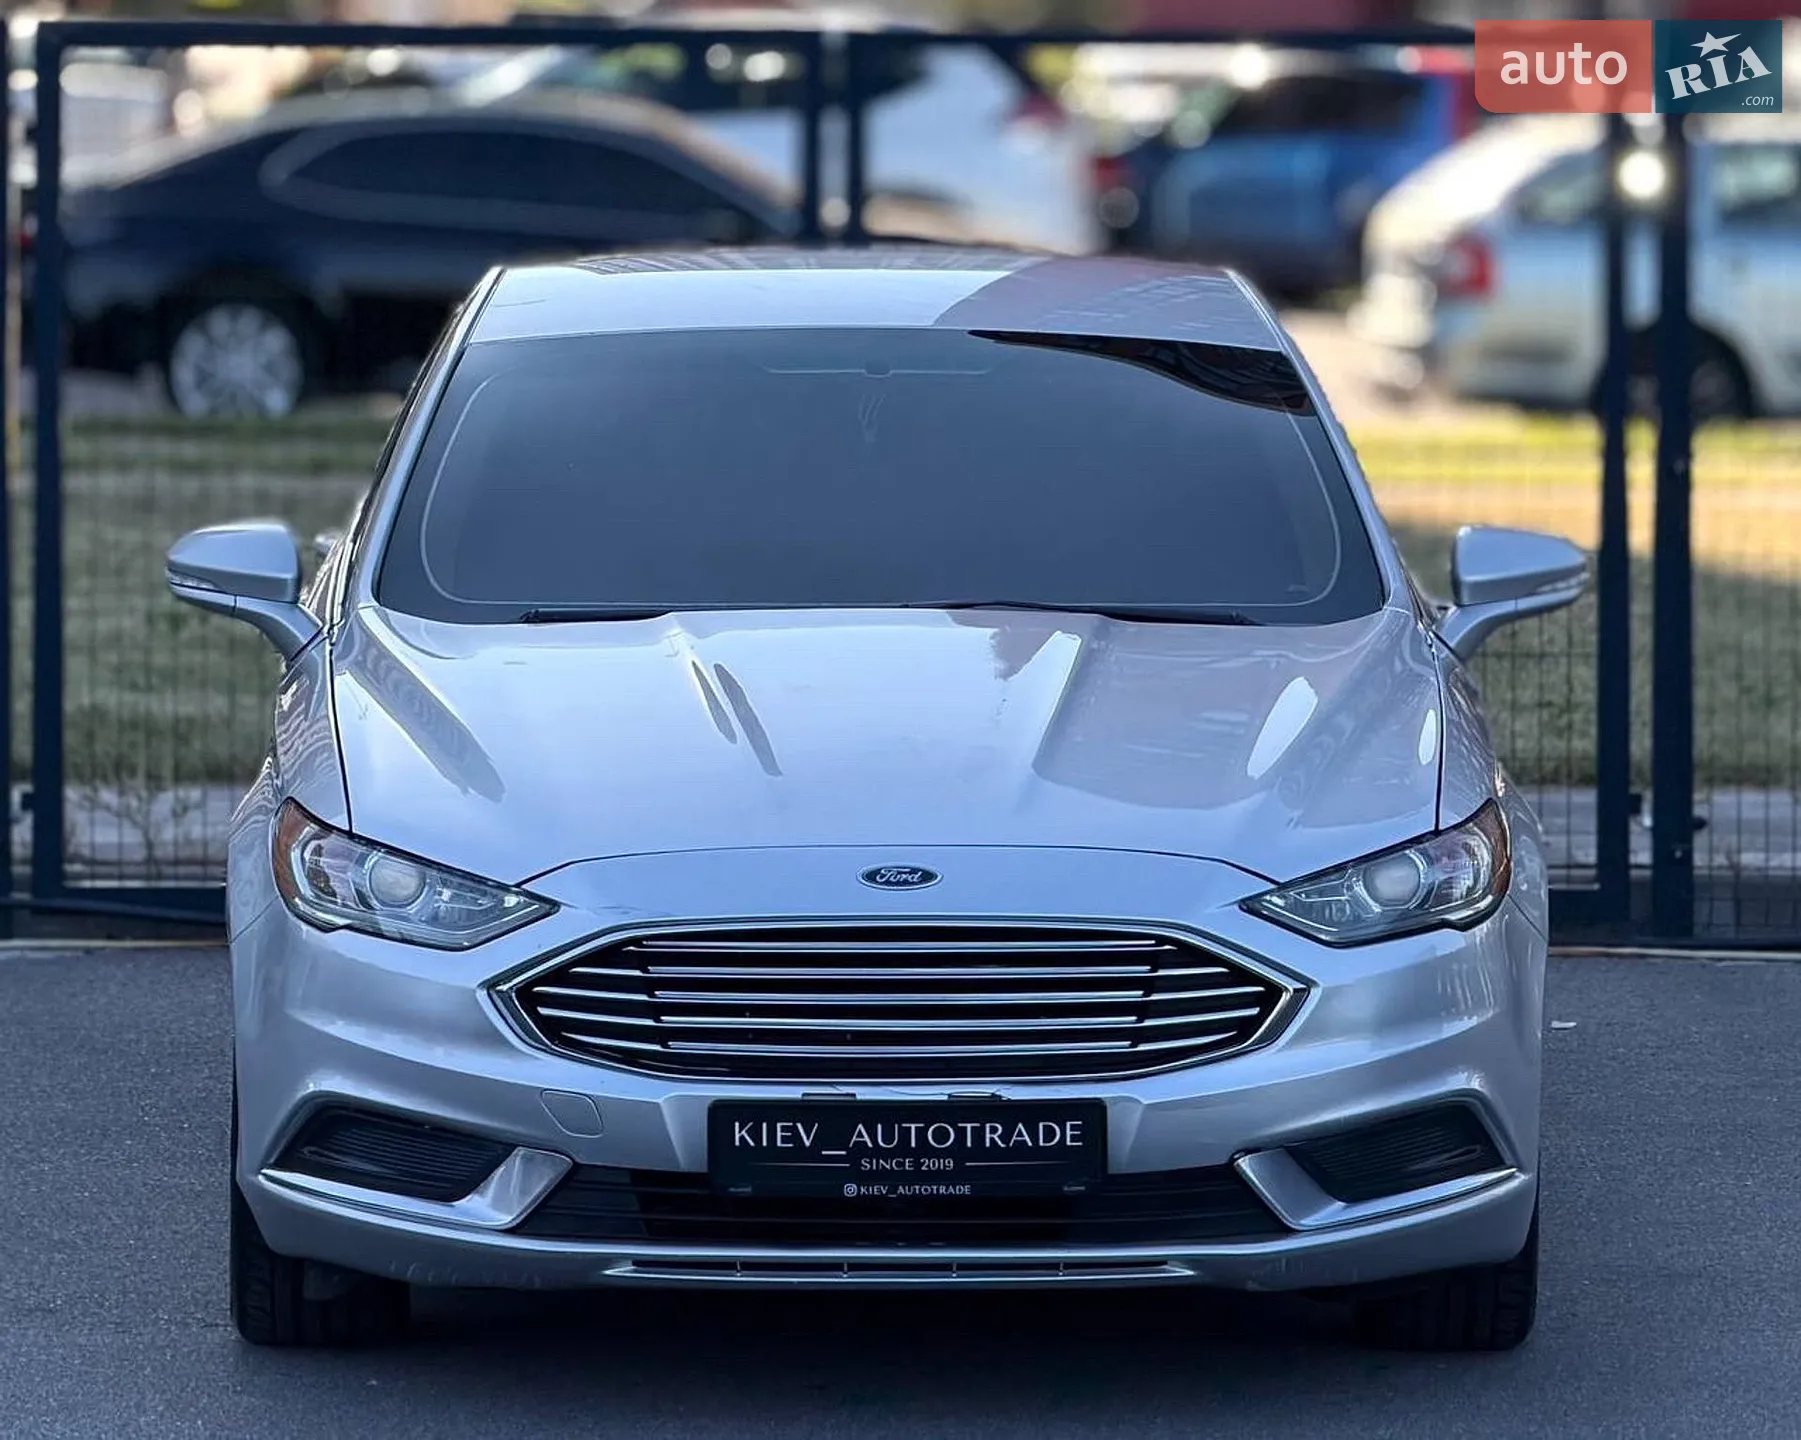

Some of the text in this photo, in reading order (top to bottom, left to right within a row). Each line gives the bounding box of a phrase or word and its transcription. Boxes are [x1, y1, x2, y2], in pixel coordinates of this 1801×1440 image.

[876, 868, 923, 882] Ford
[733, 1120, 1084, 1155] KIEV_AUTOTRADE
[860, 1157, 954, 1171] SINCE 2019
[859, 1184, 971, 1197] KIEV_AUTOTRADE
